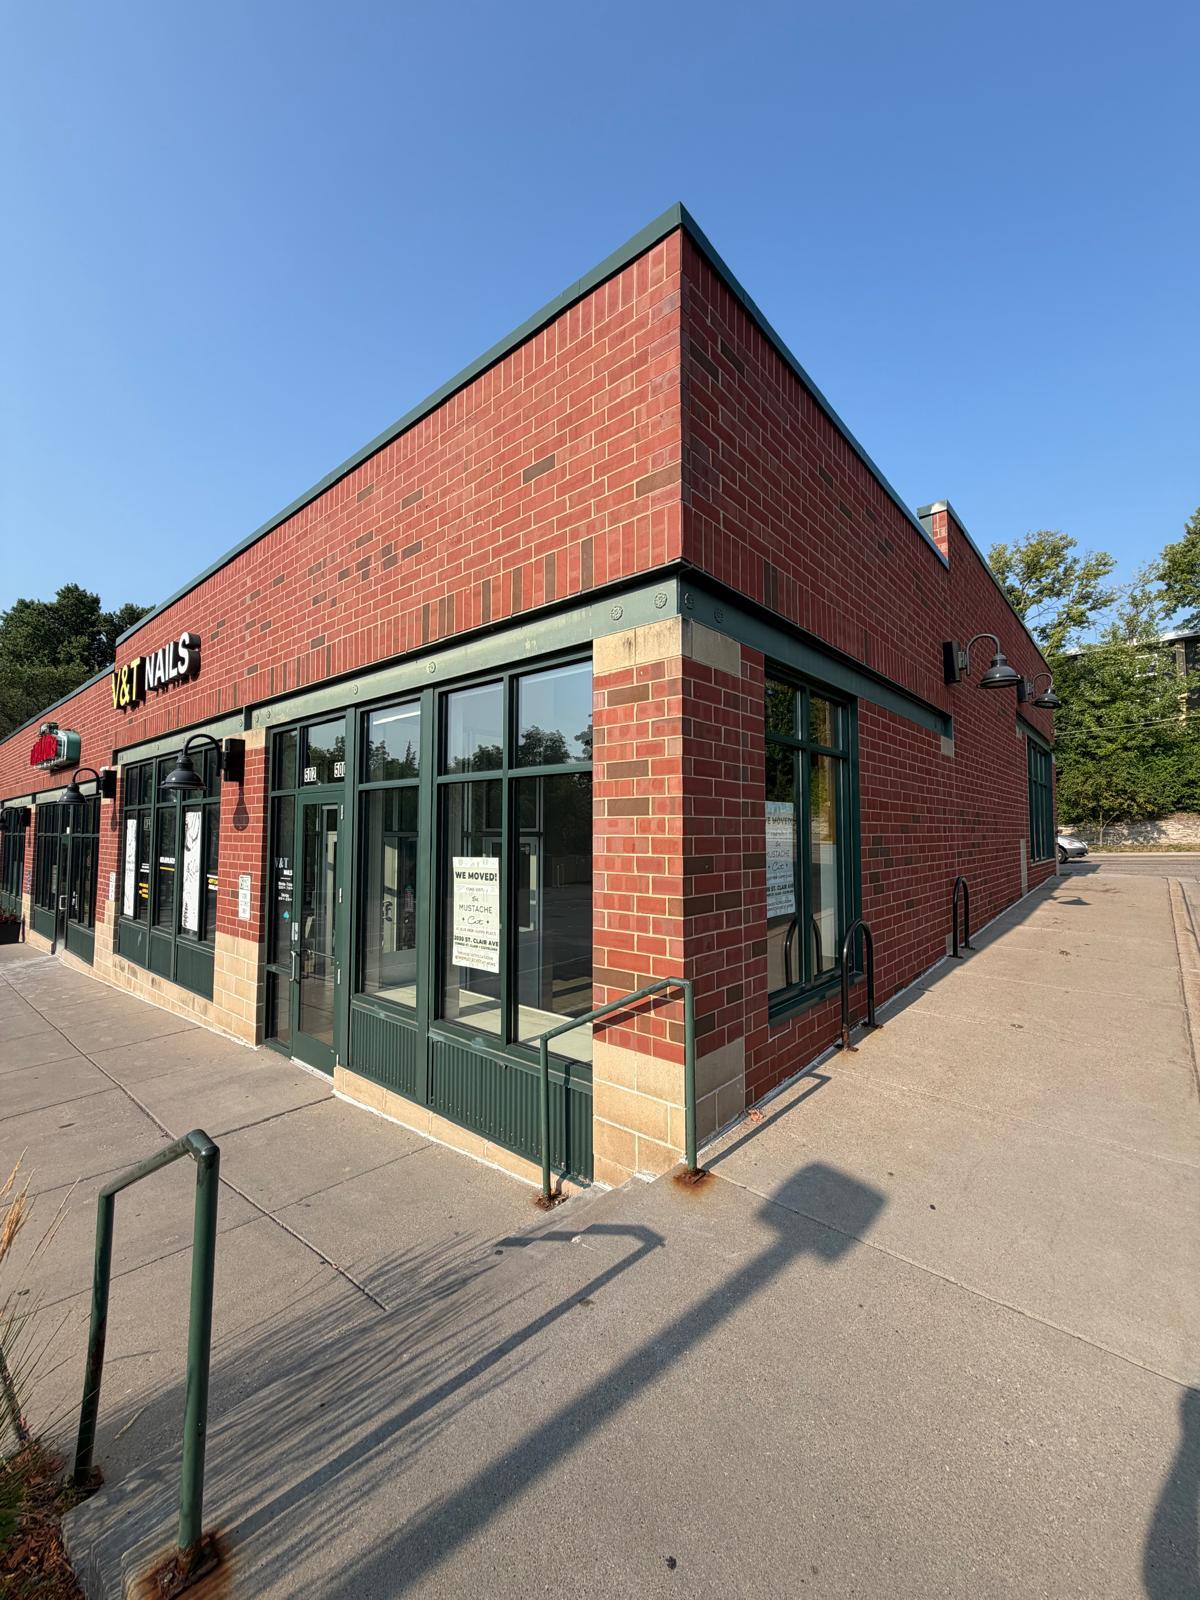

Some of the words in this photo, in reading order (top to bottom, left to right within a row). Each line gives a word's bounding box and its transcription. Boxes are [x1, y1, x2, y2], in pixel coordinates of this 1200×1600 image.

[111, 657, 141, 709] V&T
[145, 632, 191, 690] NAILS
[455, 871, 467, 880] WE
[468, 872, 498, 882] MOVED!
[459, 904, 493, 914] MUSTACHE
[467, 915, 484, 925] Cat
